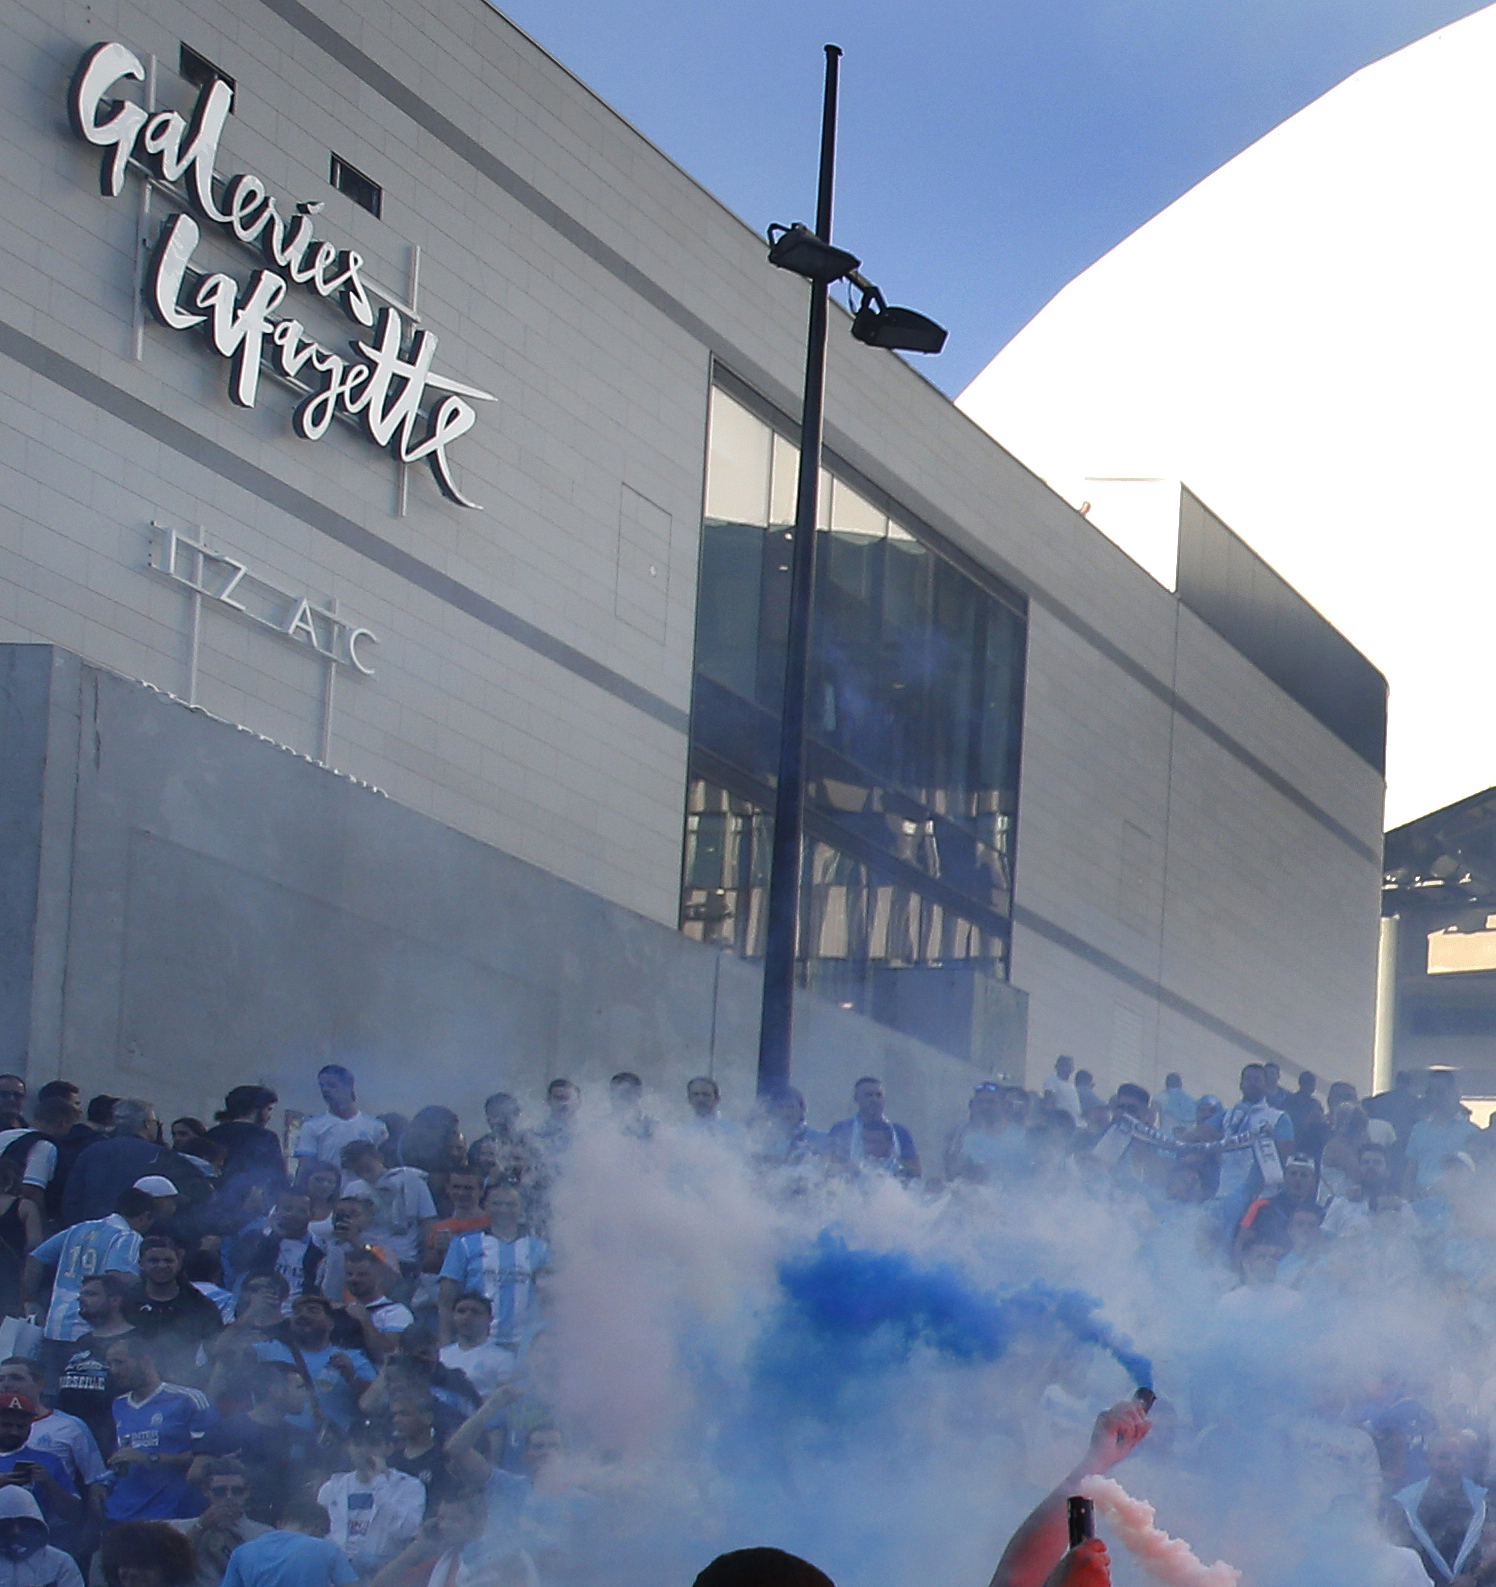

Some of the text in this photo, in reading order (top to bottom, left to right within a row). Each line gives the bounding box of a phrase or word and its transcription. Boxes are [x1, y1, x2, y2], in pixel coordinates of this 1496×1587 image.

[69, 41, 373, 326] Galeries
[149, 214, 498, 510] Lafayette
[9, 1397, 23, 1409] A
